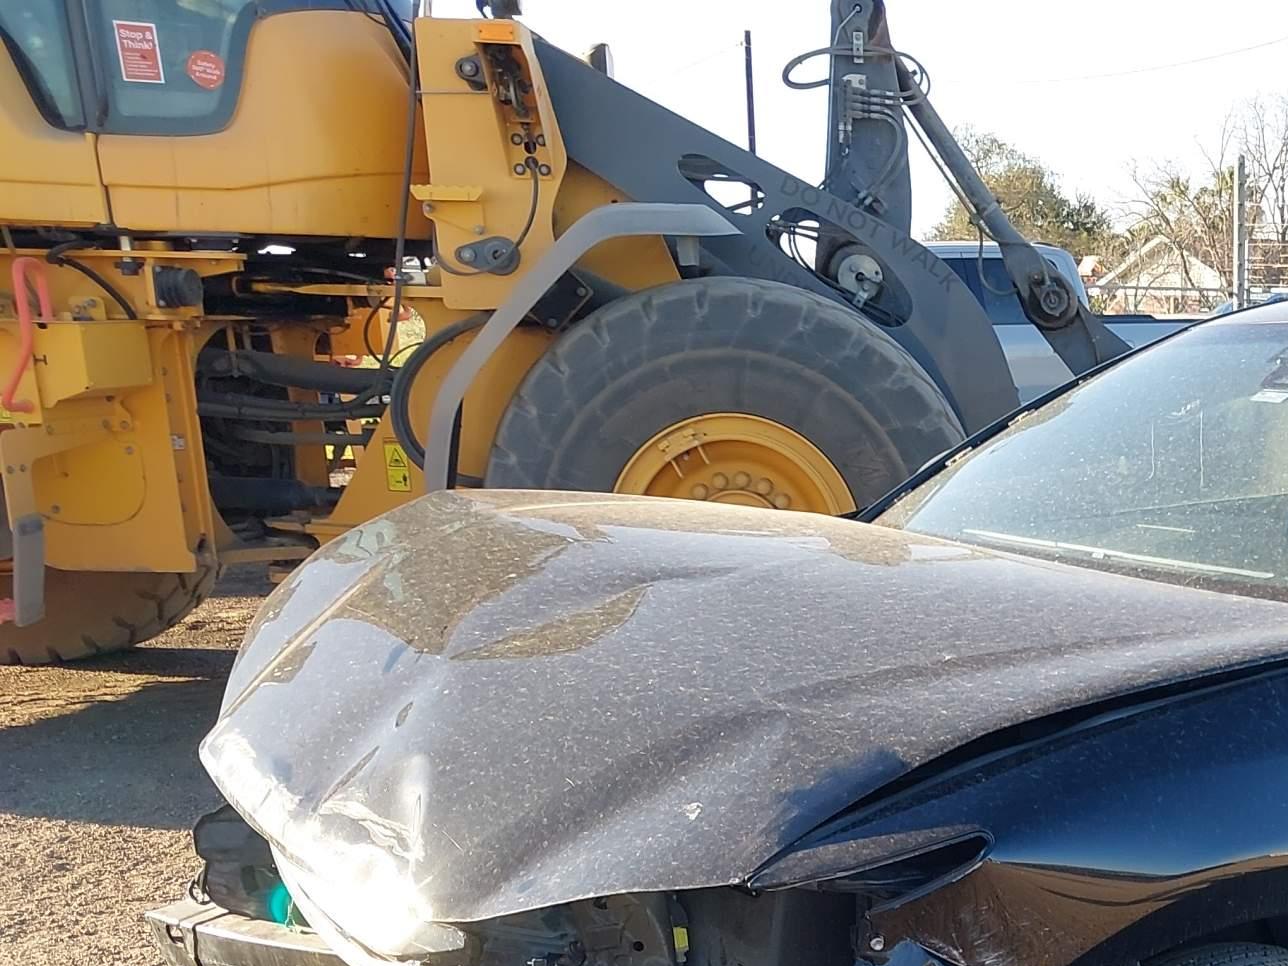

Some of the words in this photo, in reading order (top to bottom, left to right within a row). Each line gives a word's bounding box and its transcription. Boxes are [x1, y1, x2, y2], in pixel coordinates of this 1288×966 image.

[120, 28, 143, 40] Stop
[144, 31, 153, 40] &
[780, 177, 818, 205] DO
[827, 202, 886, 236] NOT
[891, 233, 956, 293] WALK
